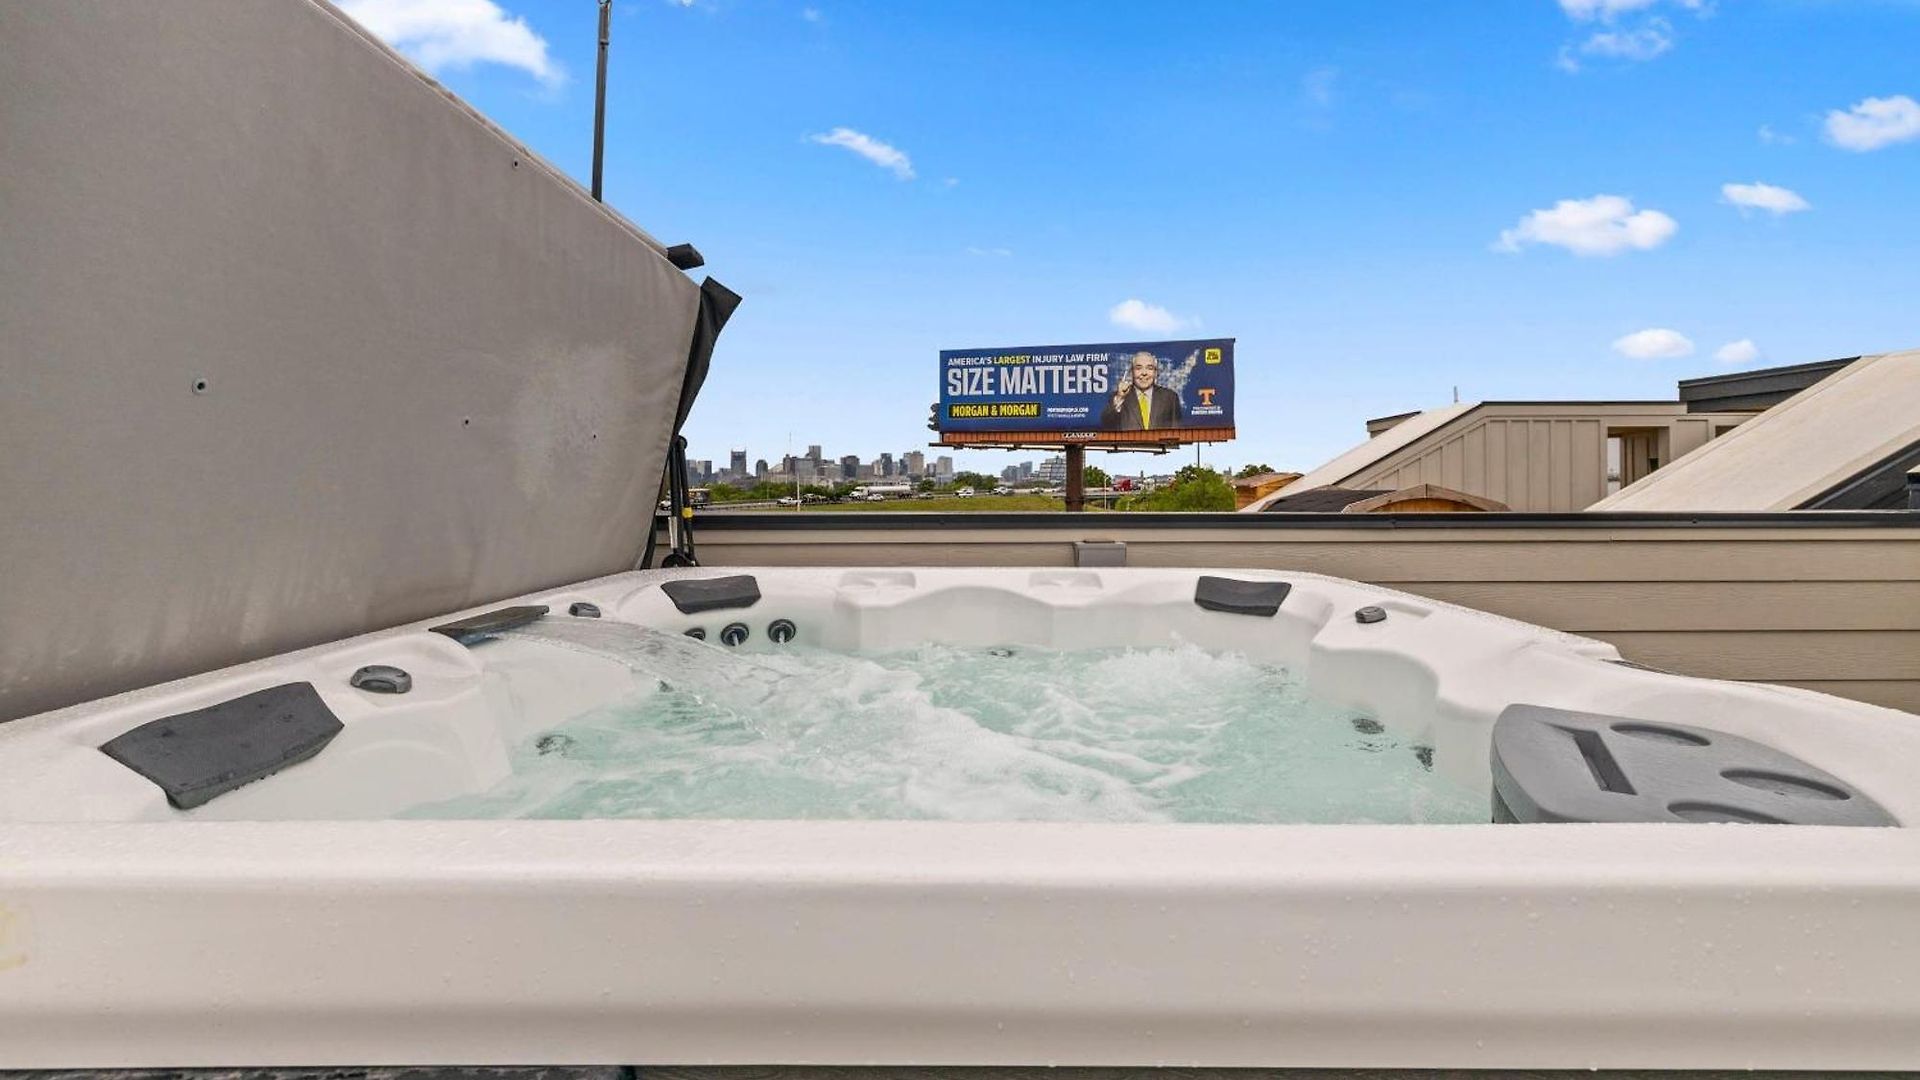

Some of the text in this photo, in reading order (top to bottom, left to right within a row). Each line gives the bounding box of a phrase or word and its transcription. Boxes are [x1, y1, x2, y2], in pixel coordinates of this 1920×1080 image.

[948, 353, 1108, 366] AMERICA'S LARGEST INJURY LAW FIRM
[947, 364, 1108, 397] SIZE MATTERS
[952, 403, 989, 418] MORGAN
[991, 404, 998, 417] &
[999, 403, 1038, 417] MORGAN
